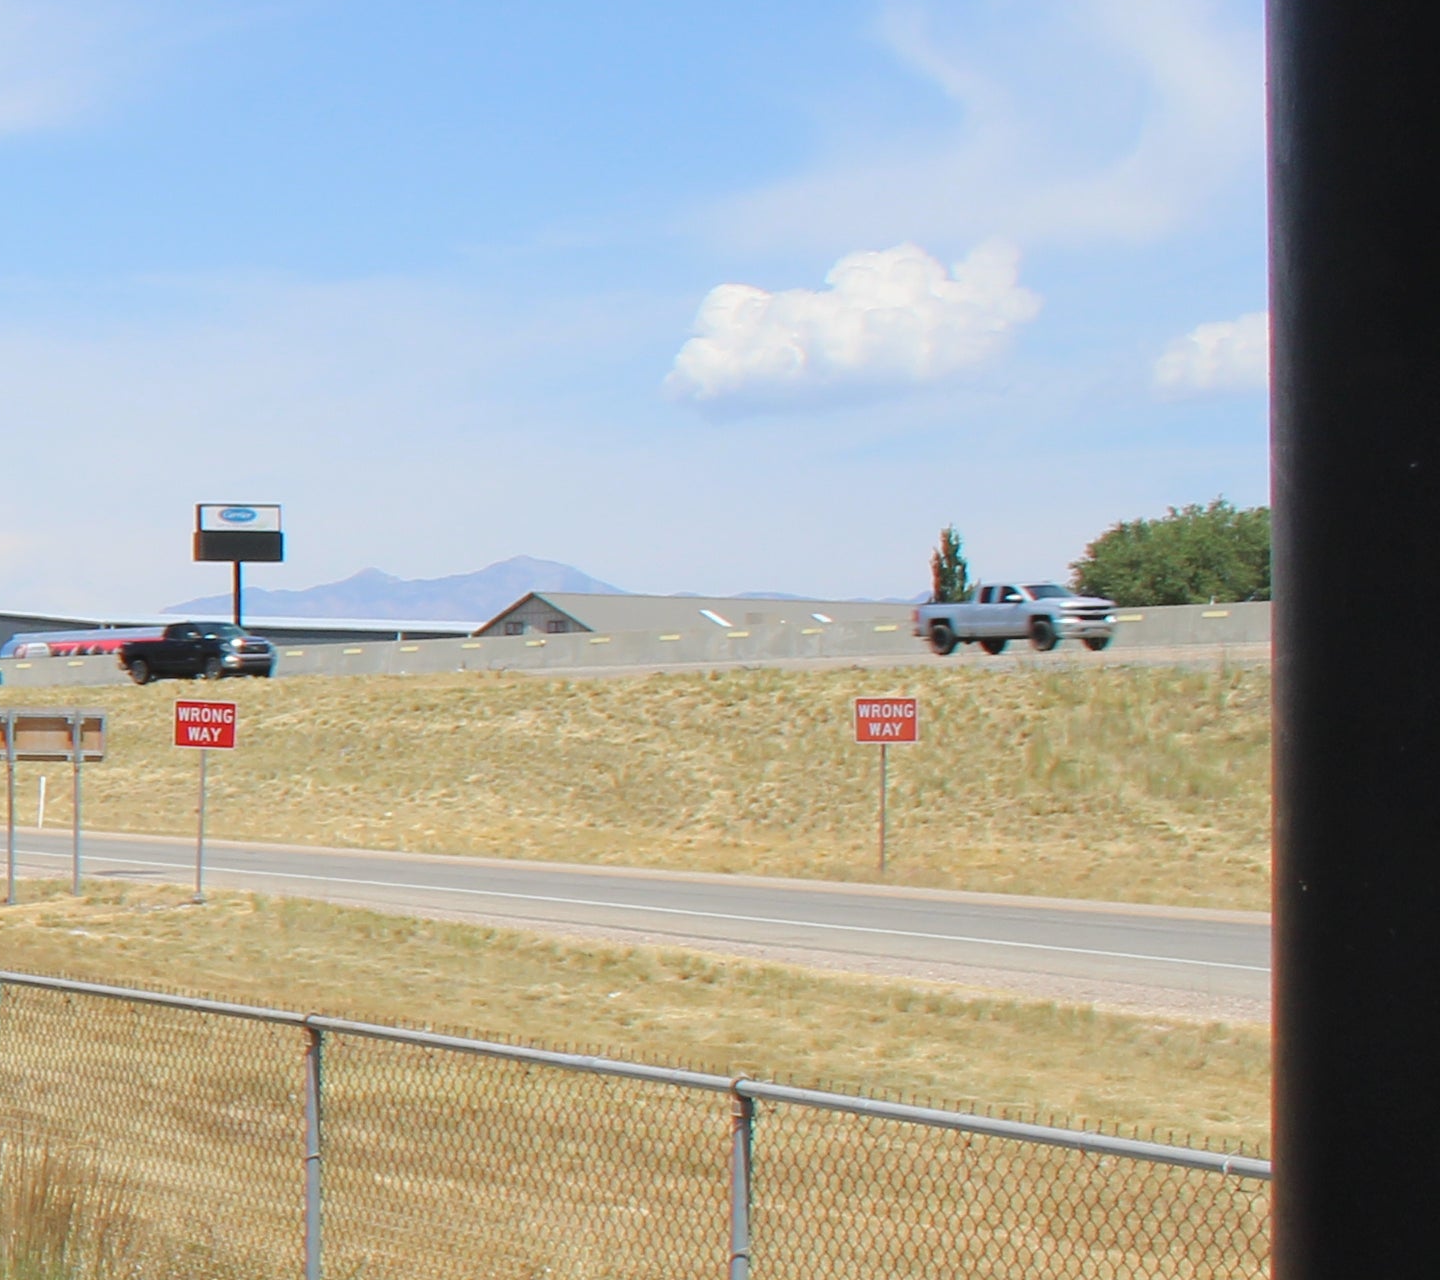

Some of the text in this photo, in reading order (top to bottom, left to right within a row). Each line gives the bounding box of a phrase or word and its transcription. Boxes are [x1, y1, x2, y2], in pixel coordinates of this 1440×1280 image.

[178, 706, 234, 724] WRONG
[858, 703, 914, 718] WRONG
[188, 726, 222, 742] WAY
[868, 722, 903, 737] WAY
